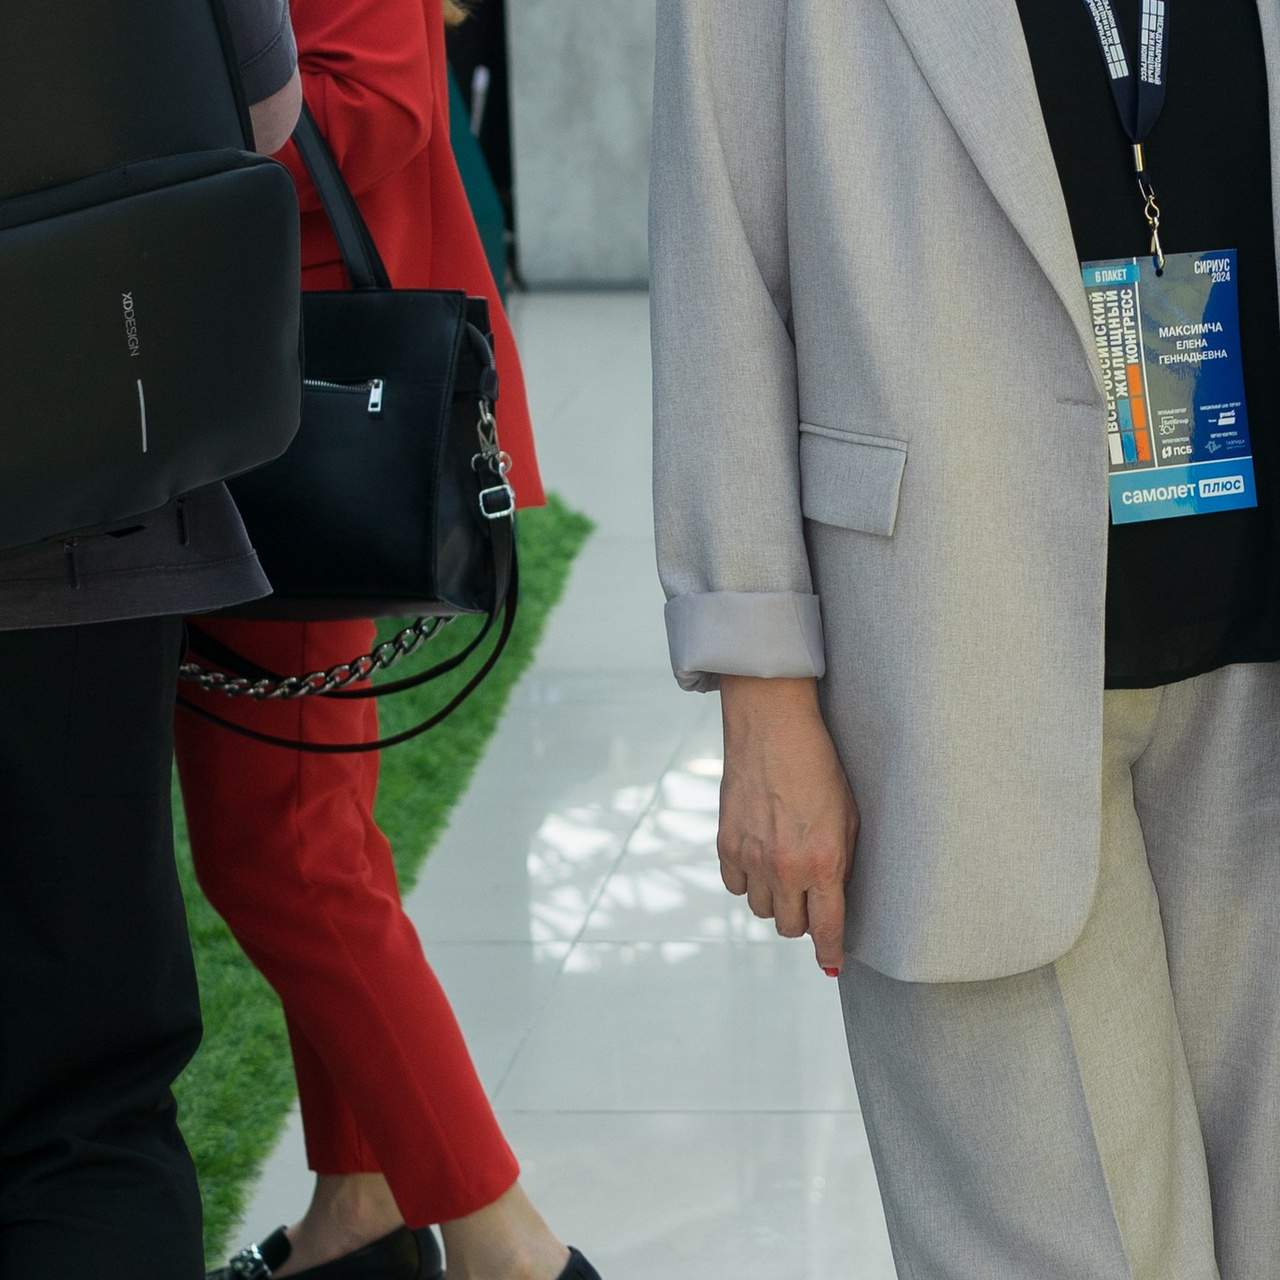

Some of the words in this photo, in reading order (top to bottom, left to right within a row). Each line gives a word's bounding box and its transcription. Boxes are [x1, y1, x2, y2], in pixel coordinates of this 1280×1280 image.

[1101, 268, 1127, 281] ПАКЕТ
[1194, 258, 1230, 275] СИРИУС
[1211, 271, 1231, 283] 2024
[1120, 288, 1138, 363] КОНГРЕСС
[1158, 322, 1223, 338] МАКСИМЧА
[1102, 289, 1128, 397] ЖИЛИЩНЫЙ
[1176, 337, 1208, 350] ЕЛЕНА
[1158, 349, 1228, 365] ГЕННАДЬЕВНА
[1173, 445, 1192, 456] ПСБ
[1122, 482, 1196, 505] самолет
